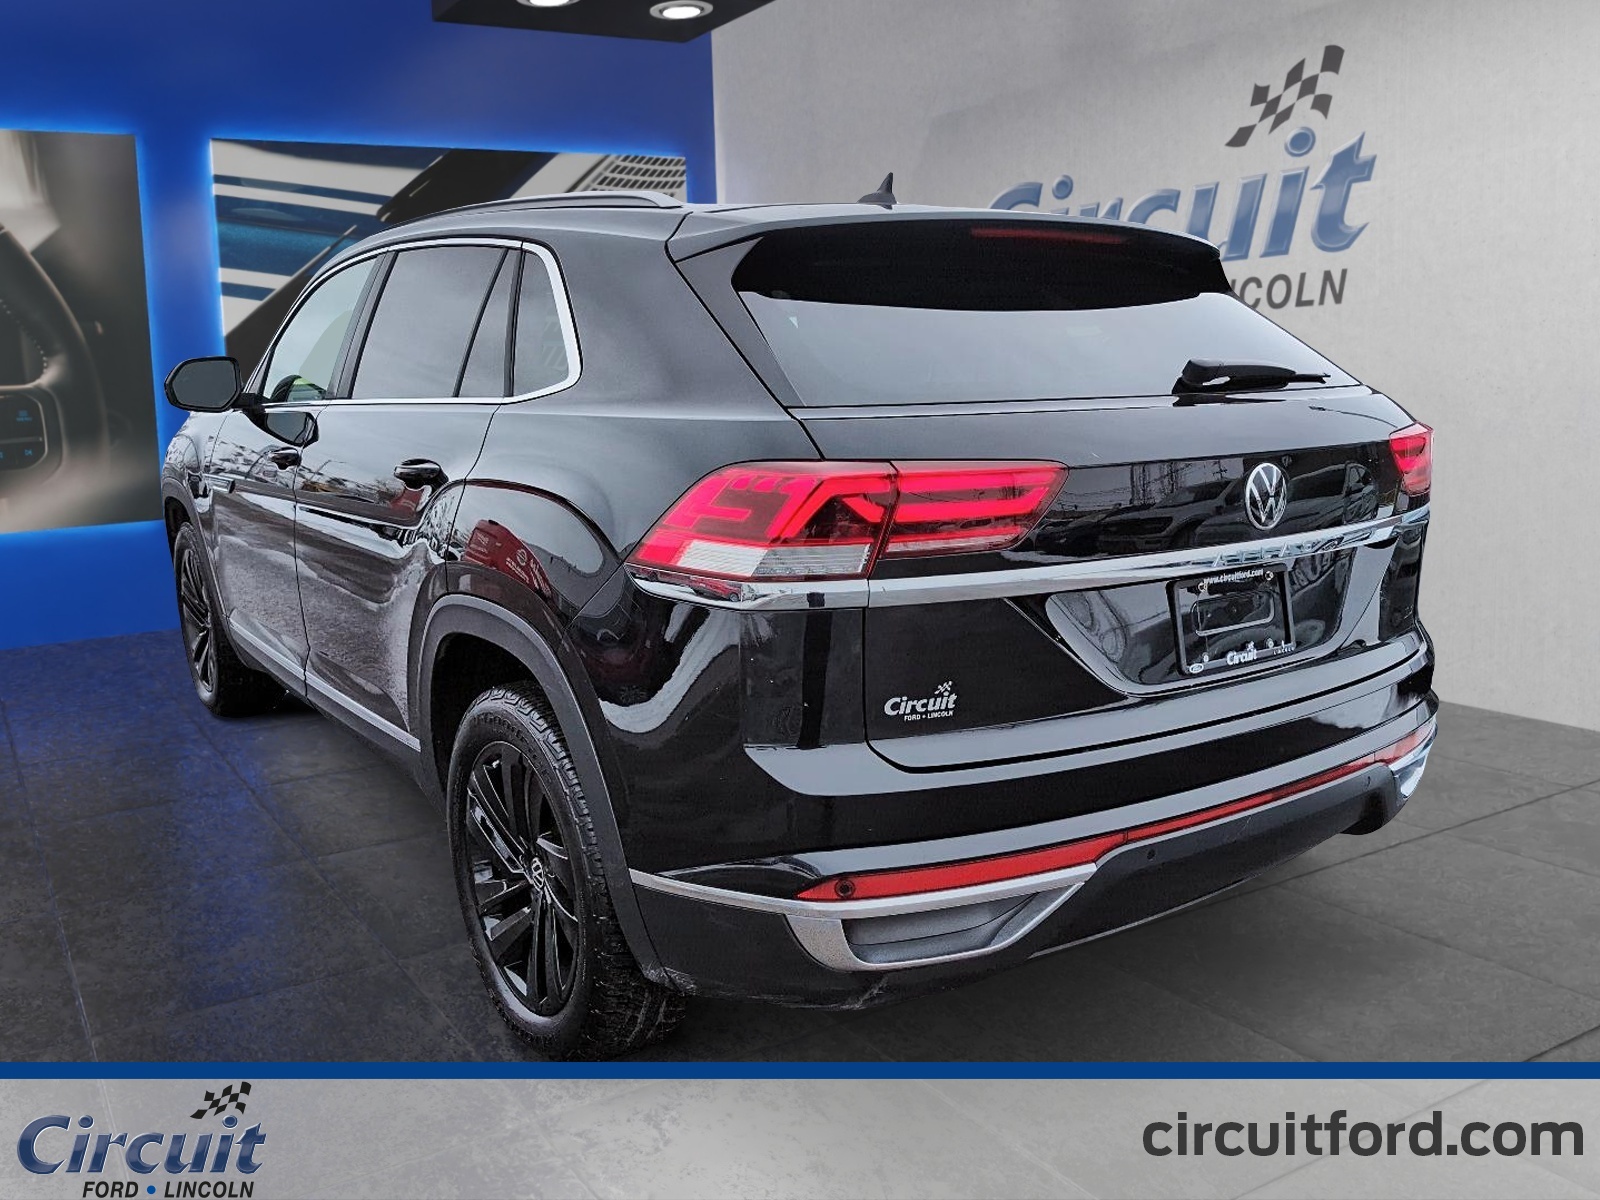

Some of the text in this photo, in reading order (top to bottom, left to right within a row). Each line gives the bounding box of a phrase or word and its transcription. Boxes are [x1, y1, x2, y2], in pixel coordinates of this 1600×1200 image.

[990, 127, 1378, 262] cuit
[1229, 268, 1348, 310] COLN
[1226, 647, 1257, 666] Circuit
[884, 691, 957, 715] Circuit
[904, 710, 955, 722] FORD LINCOLN
